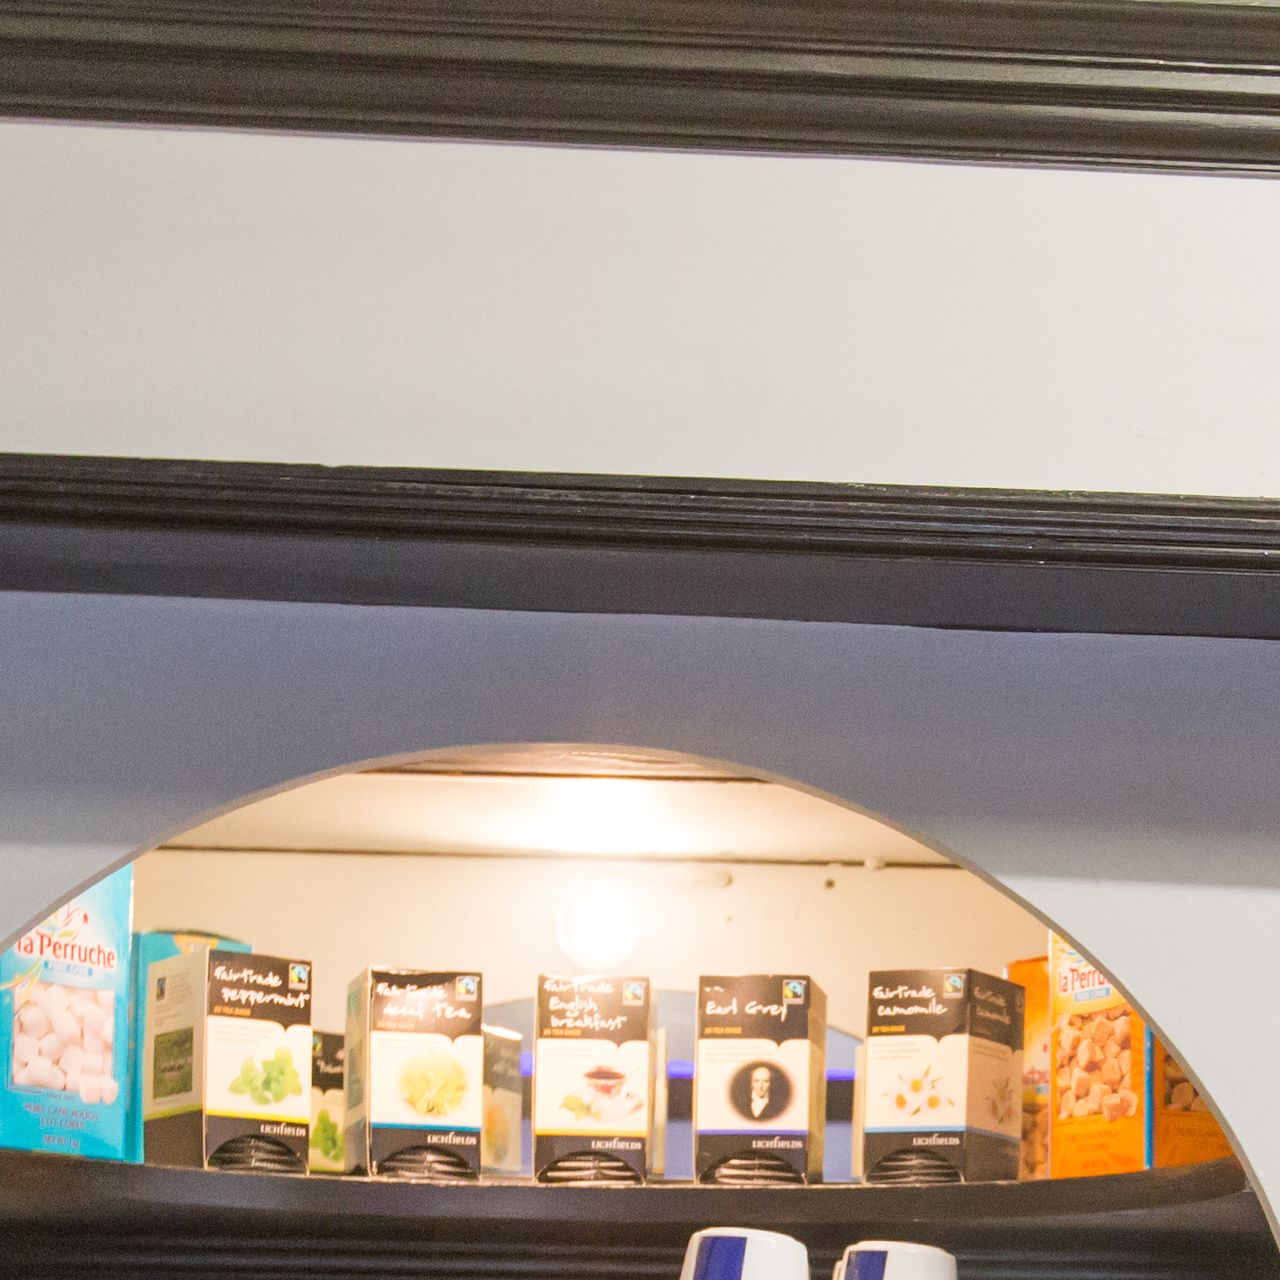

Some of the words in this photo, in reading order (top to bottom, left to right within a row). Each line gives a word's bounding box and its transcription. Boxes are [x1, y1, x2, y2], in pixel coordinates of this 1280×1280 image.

[35, 928, 116, 969] Perruche
[1058, 972, 1068, 993] la
[1069, 966, 1108, 991] Perru
[221, 988, 310, 1008] peppermint
[877, 998, 948, 1016] camomile
[705, 997, 738, 1015] Earl
[745, 1001, 788, 1022] Grey
[551, 1012, 628, 1031] breakfast
